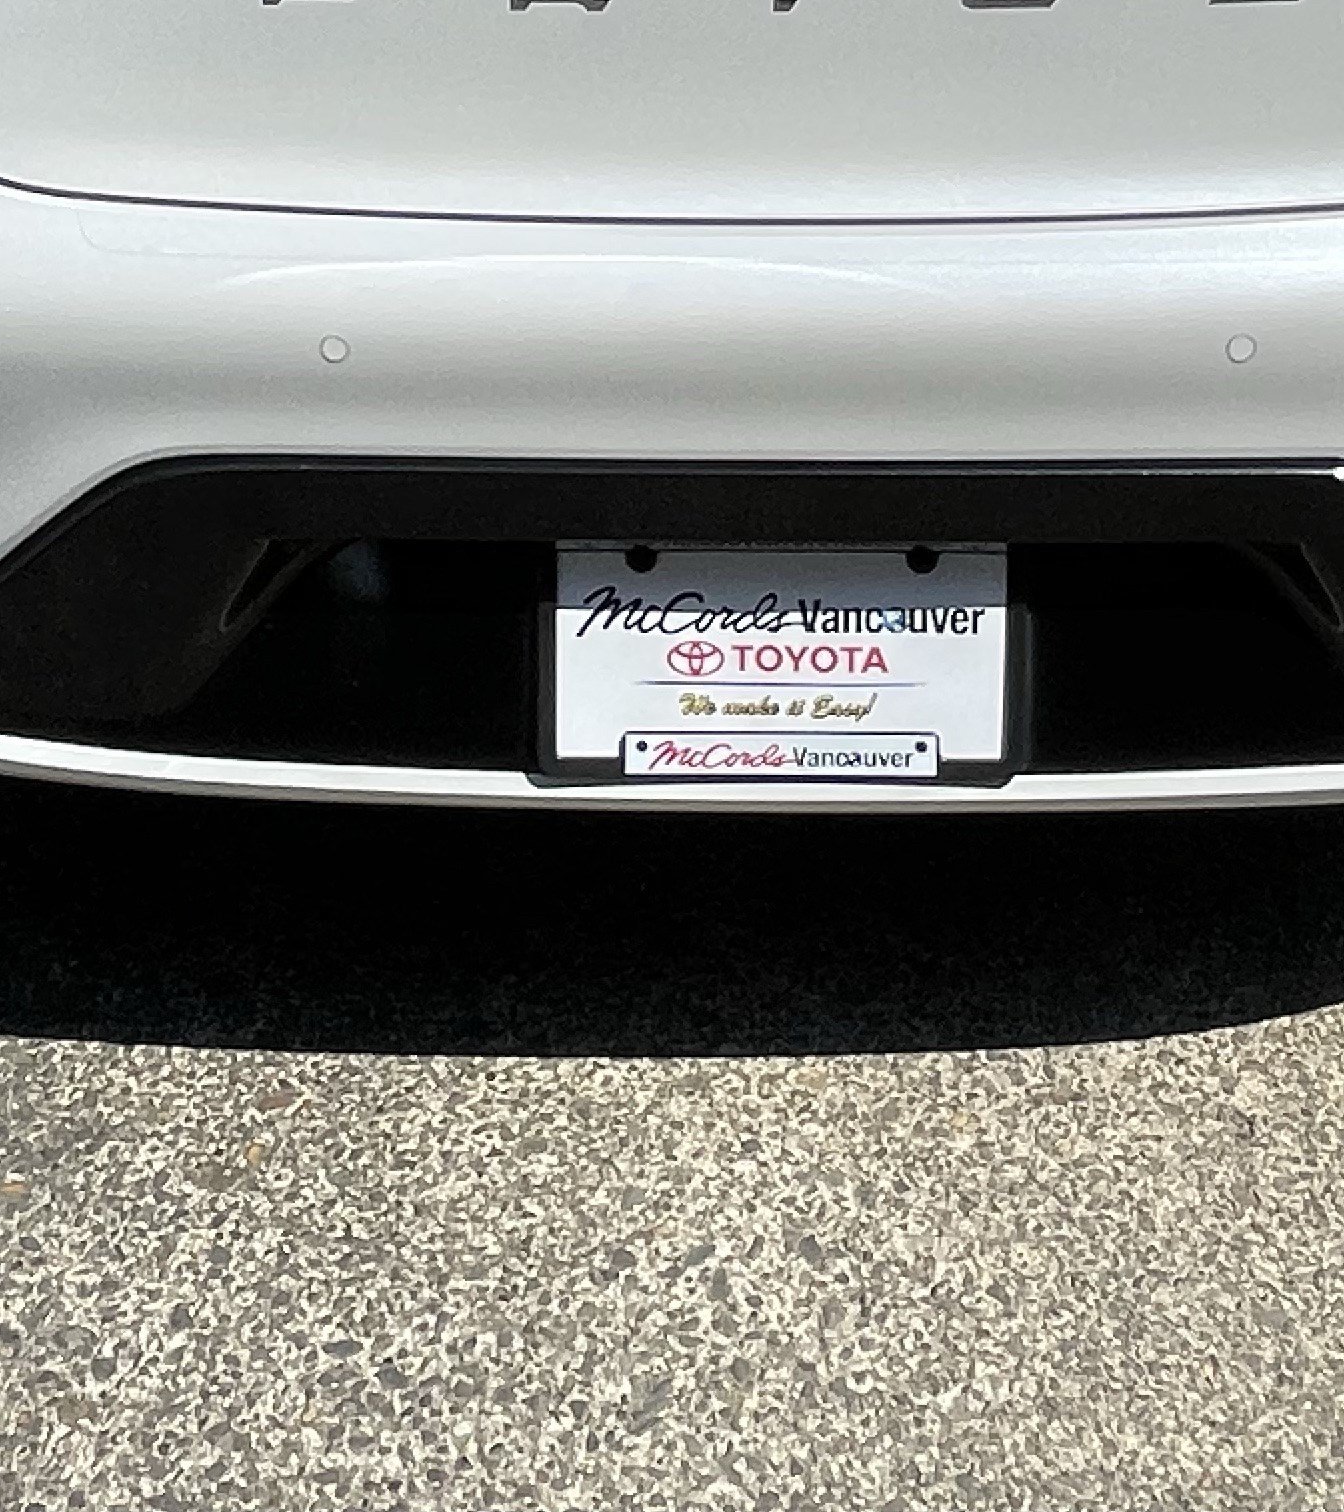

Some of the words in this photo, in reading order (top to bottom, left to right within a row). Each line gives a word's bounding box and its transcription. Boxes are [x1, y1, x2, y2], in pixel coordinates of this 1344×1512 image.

[576, 585, 798, 638] McCords
[798, 598, 986, 636] Vancouver
[731, 645, 888, 675] TOYOTA
[678, 692, 717, 716] We
[722, 694, 780, 716] make
[785, 697, 806, 716] it
[810, 692, 878, 722] Easy!
[647, 740, 792, 771] McCords
[792, 746, 914, 769] Vancouver
